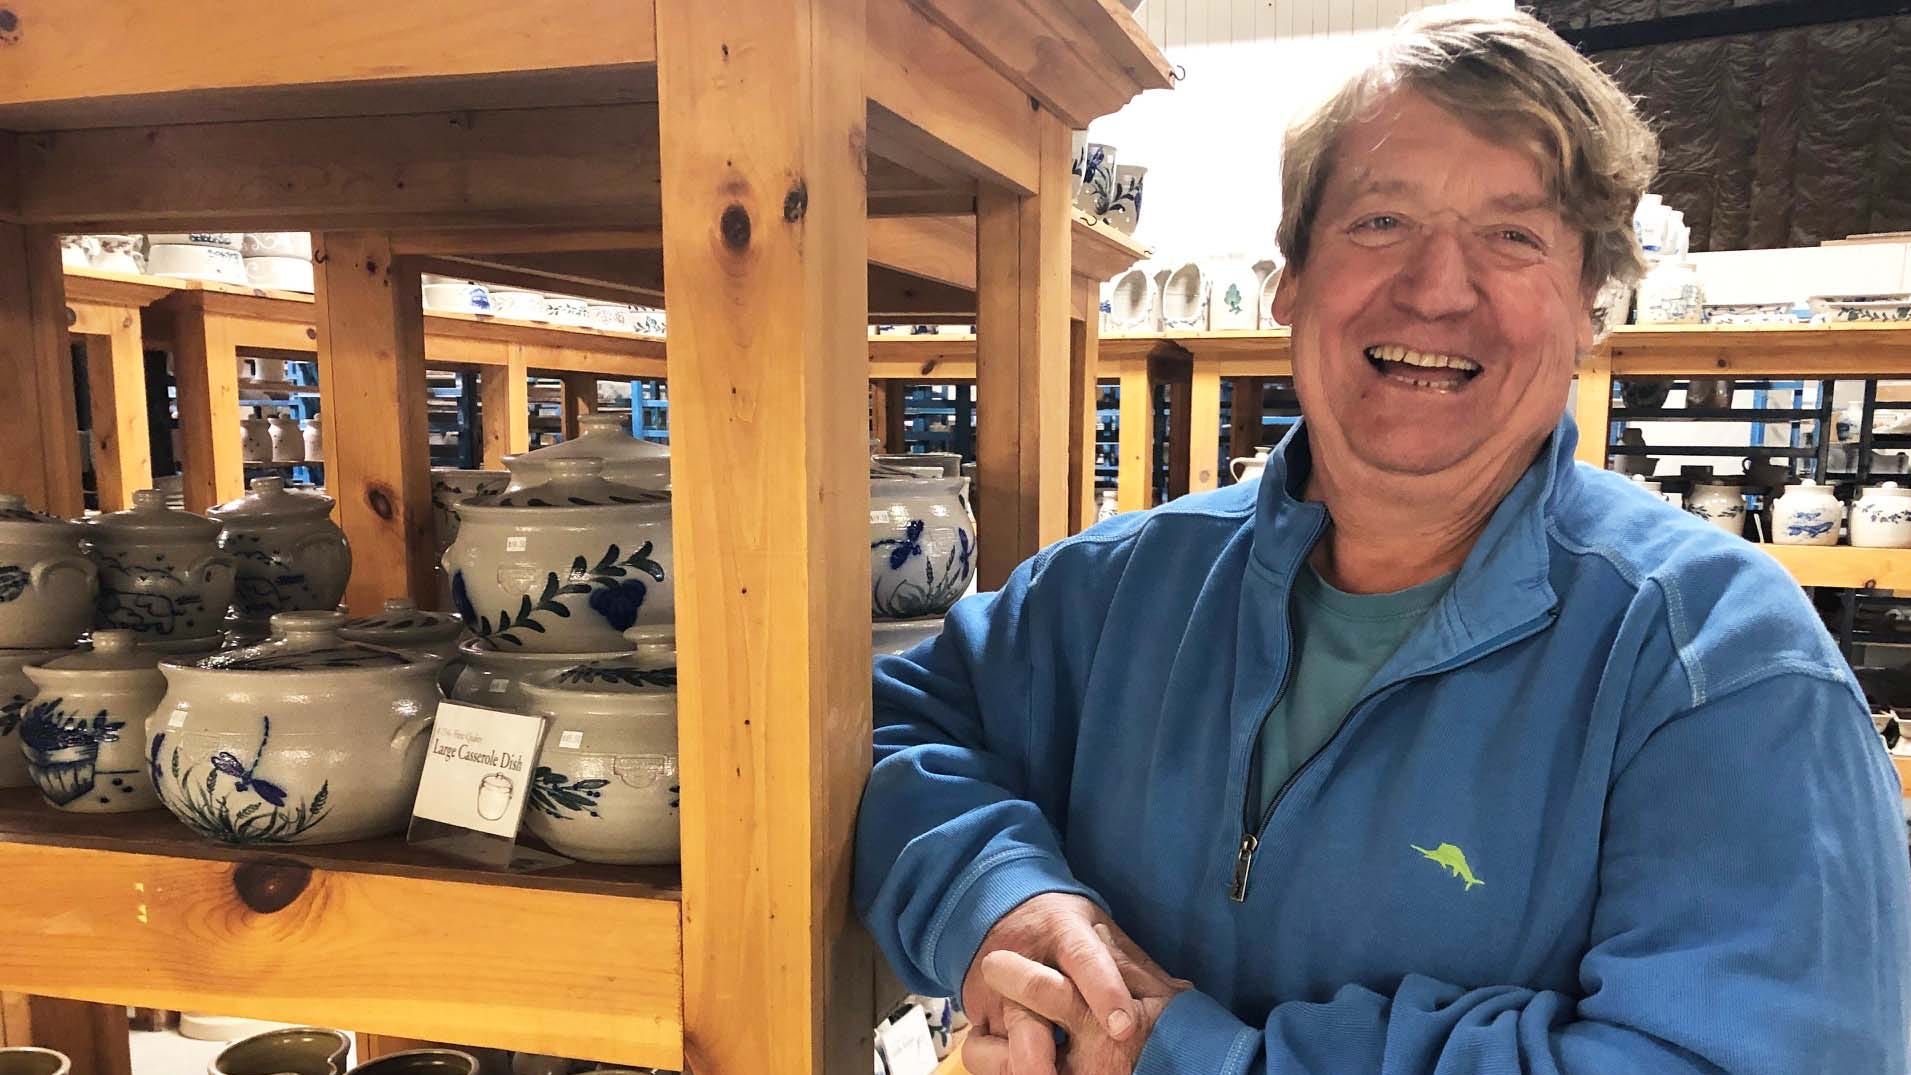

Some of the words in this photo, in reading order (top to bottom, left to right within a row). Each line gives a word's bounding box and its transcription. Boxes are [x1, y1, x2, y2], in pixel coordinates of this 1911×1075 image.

[432, 738, 457, 762] Large
[458, 744, 498, 767] Casserole
[500, 752, 523, 771] Dish
